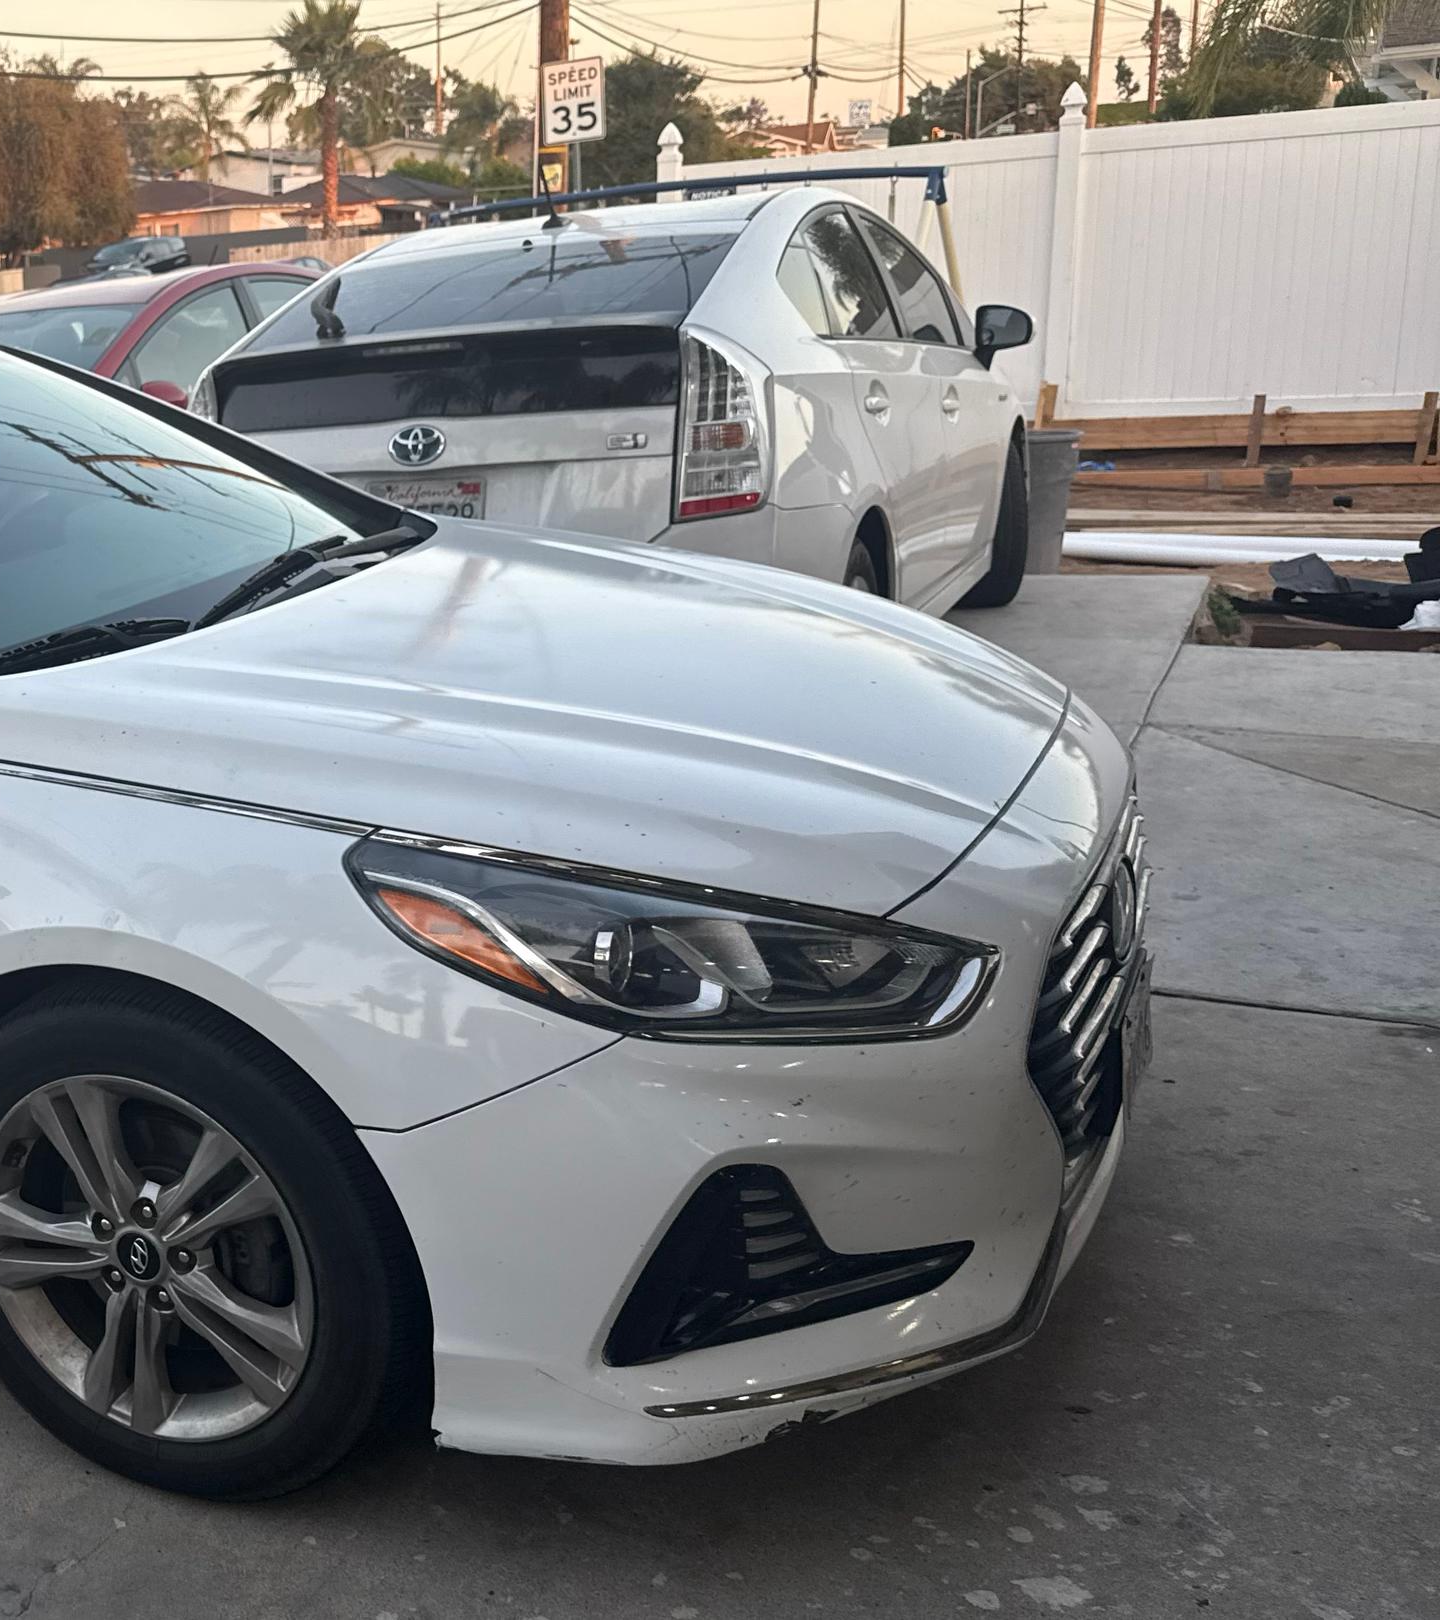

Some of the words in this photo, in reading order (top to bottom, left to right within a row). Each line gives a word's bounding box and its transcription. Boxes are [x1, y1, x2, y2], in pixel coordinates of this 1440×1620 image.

[548, 67, 598, 86] SPEED
[553, 84, 592, 102] LIMIT
[551, 101, 597, 134] 35
[384, 484, 458, 503] California
